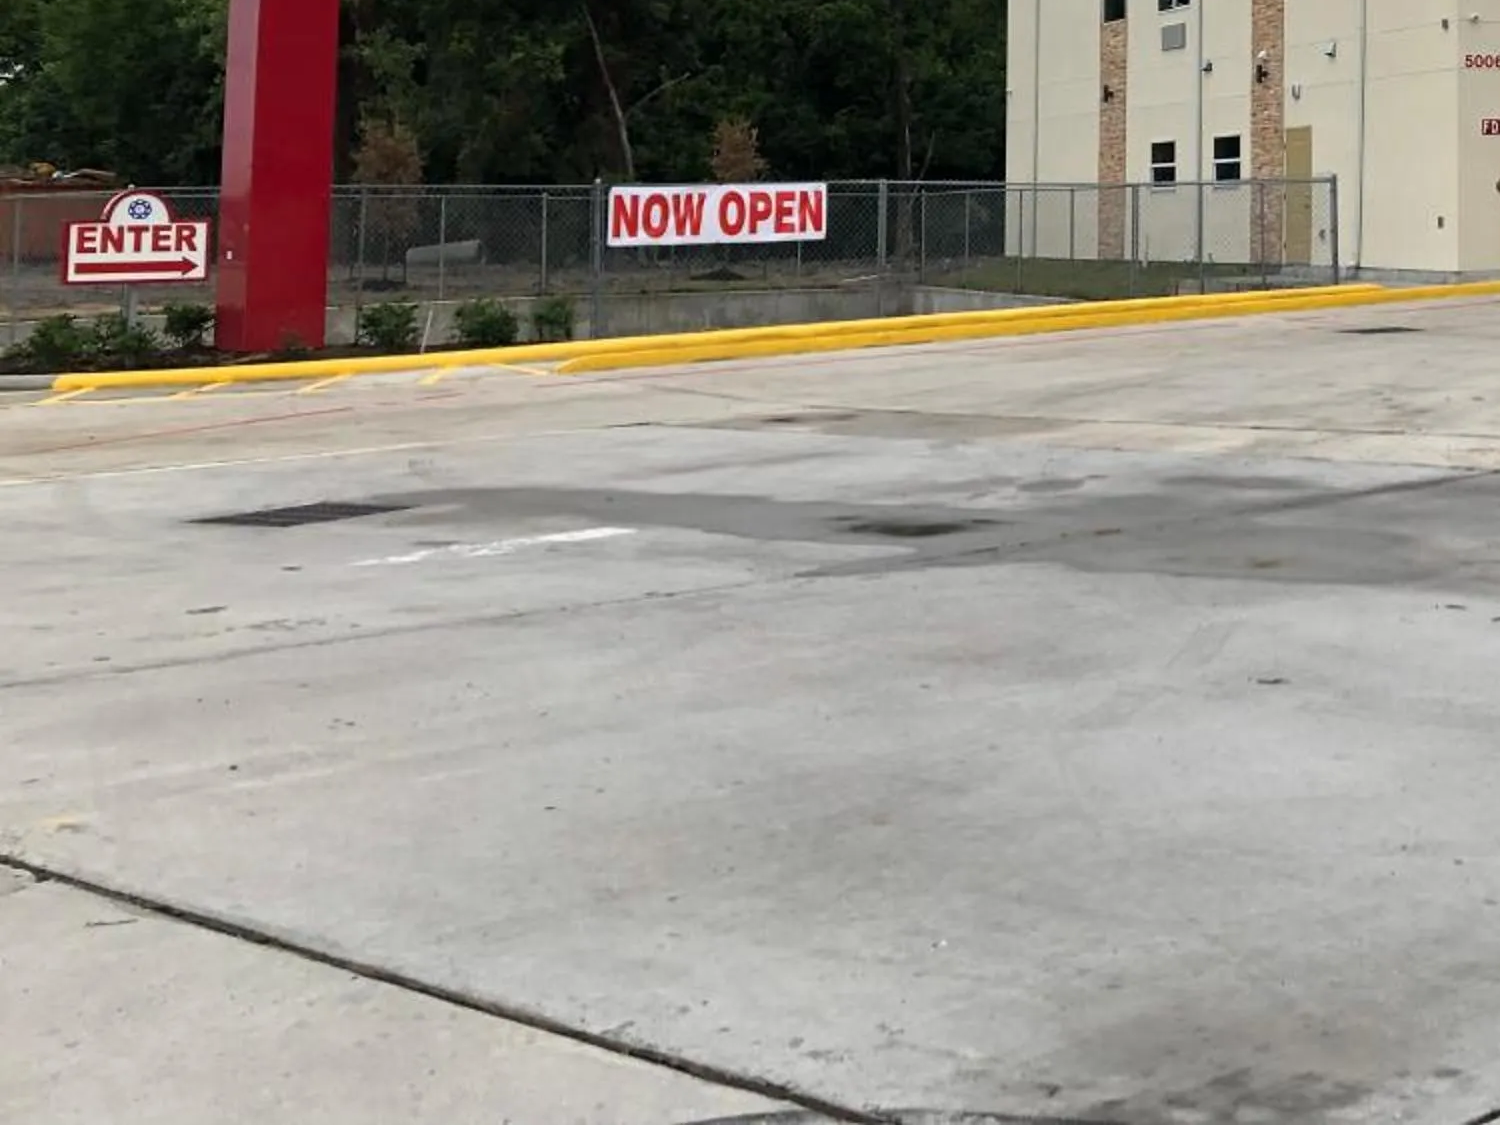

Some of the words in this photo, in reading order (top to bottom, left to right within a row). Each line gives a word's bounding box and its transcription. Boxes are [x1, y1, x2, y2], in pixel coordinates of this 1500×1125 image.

[611, 194, 706, 238] NOW
[719, 190, 823, 236] OPEN
[75, 225, 197, 254] ENTER
